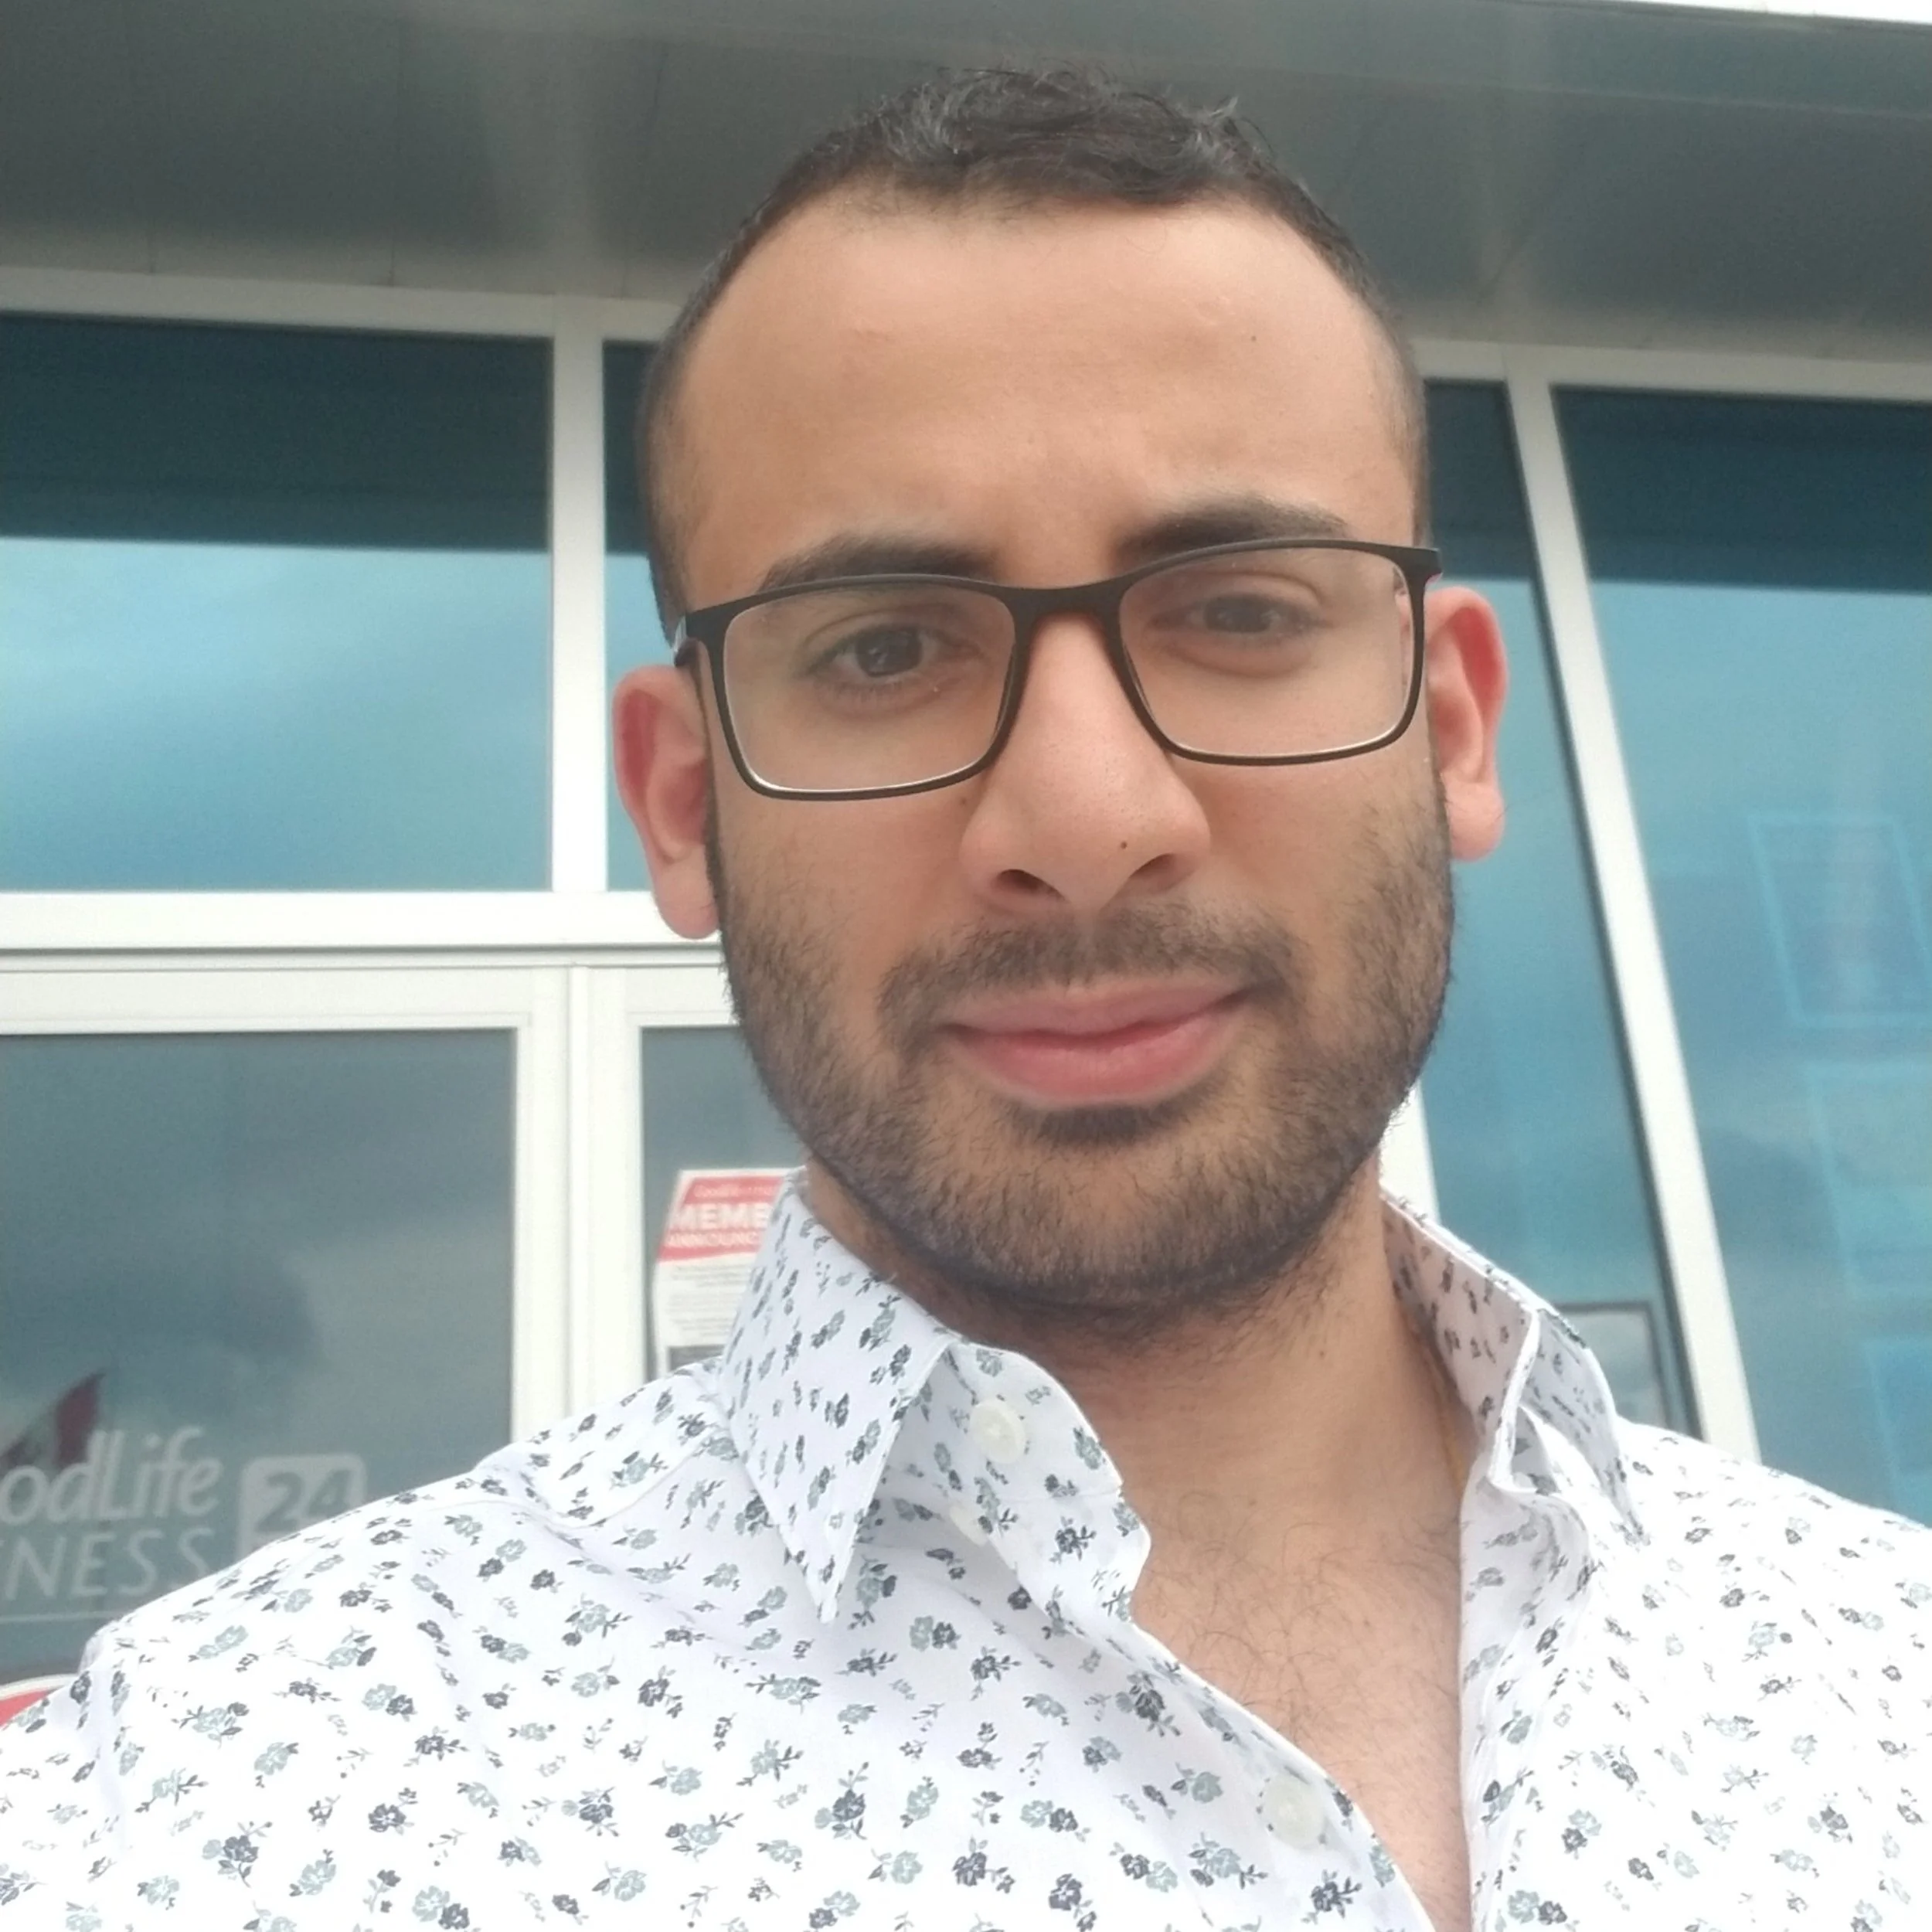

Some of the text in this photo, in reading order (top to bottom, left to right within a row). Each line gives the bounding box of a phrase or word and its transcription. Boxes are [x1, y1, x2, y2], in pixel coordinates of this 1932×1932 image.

[0, 1427, 224, 1526] odLife
[254, 1470, 351, 1532] 24
[0, 1528, 216, 1600] NESS
